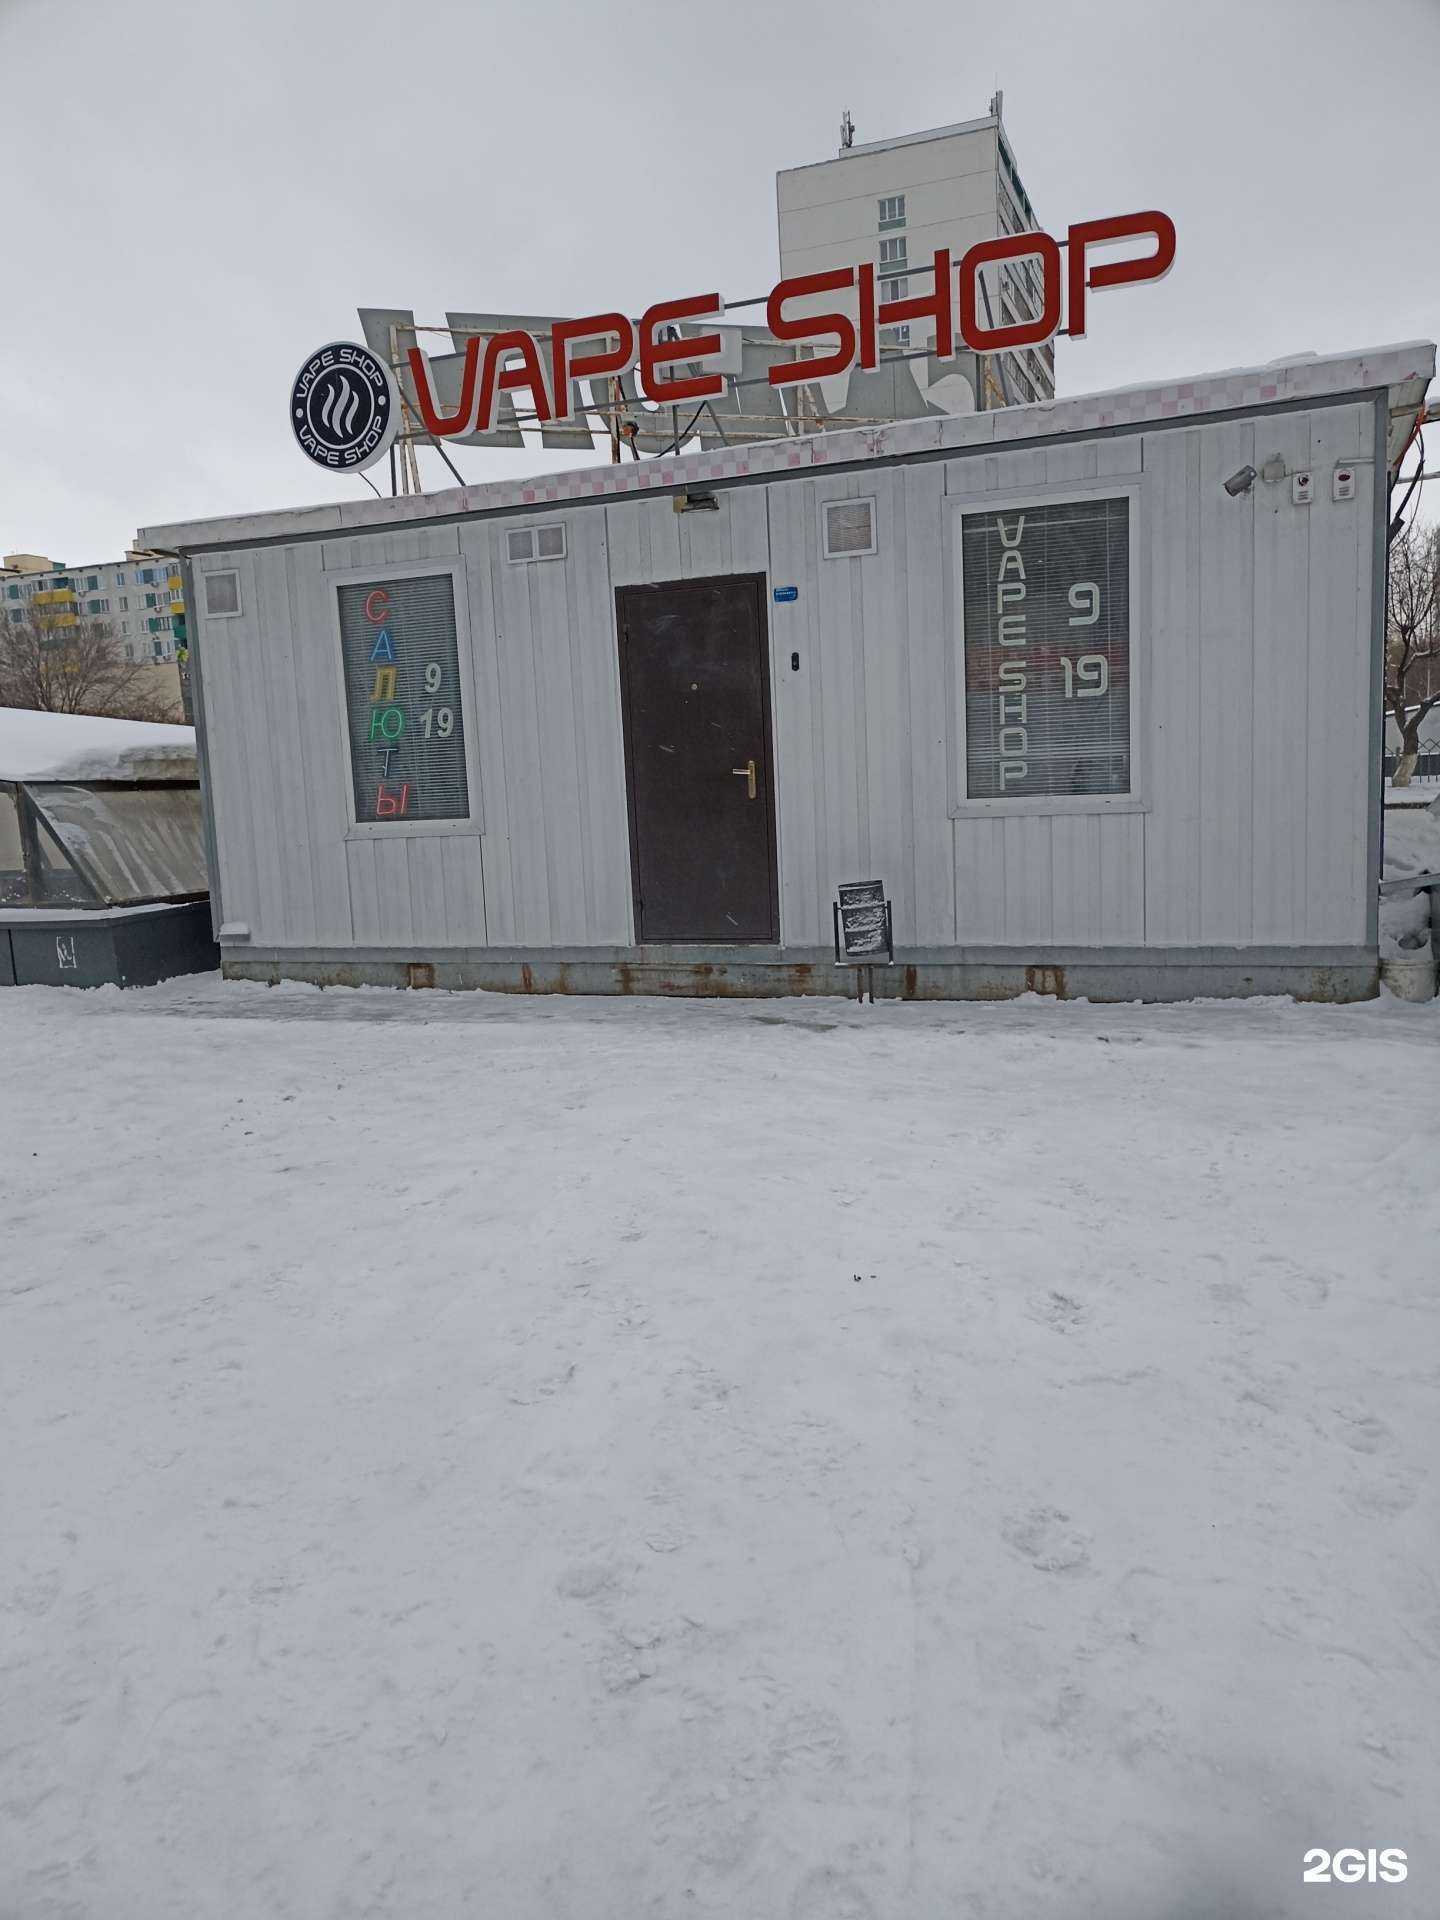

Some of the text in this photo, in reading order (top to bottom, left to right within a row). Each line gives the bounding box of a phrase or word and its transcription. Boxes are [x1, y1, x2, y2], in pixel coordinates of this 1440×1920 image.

[407, 210, 1177, 437] VAPE SHOP
[296, 348, 383, 398] VAPE SHOP
[299, 415, 382, 465] VAPE SHOP
[1068, 581, 1100, 626] 9
[997, 515, 1028, 791] VAPE SHOP
[1060, 654, 1109, 698] 19
[424, 662, 442, 693] 9
[420, 707, 454, 738] 19
